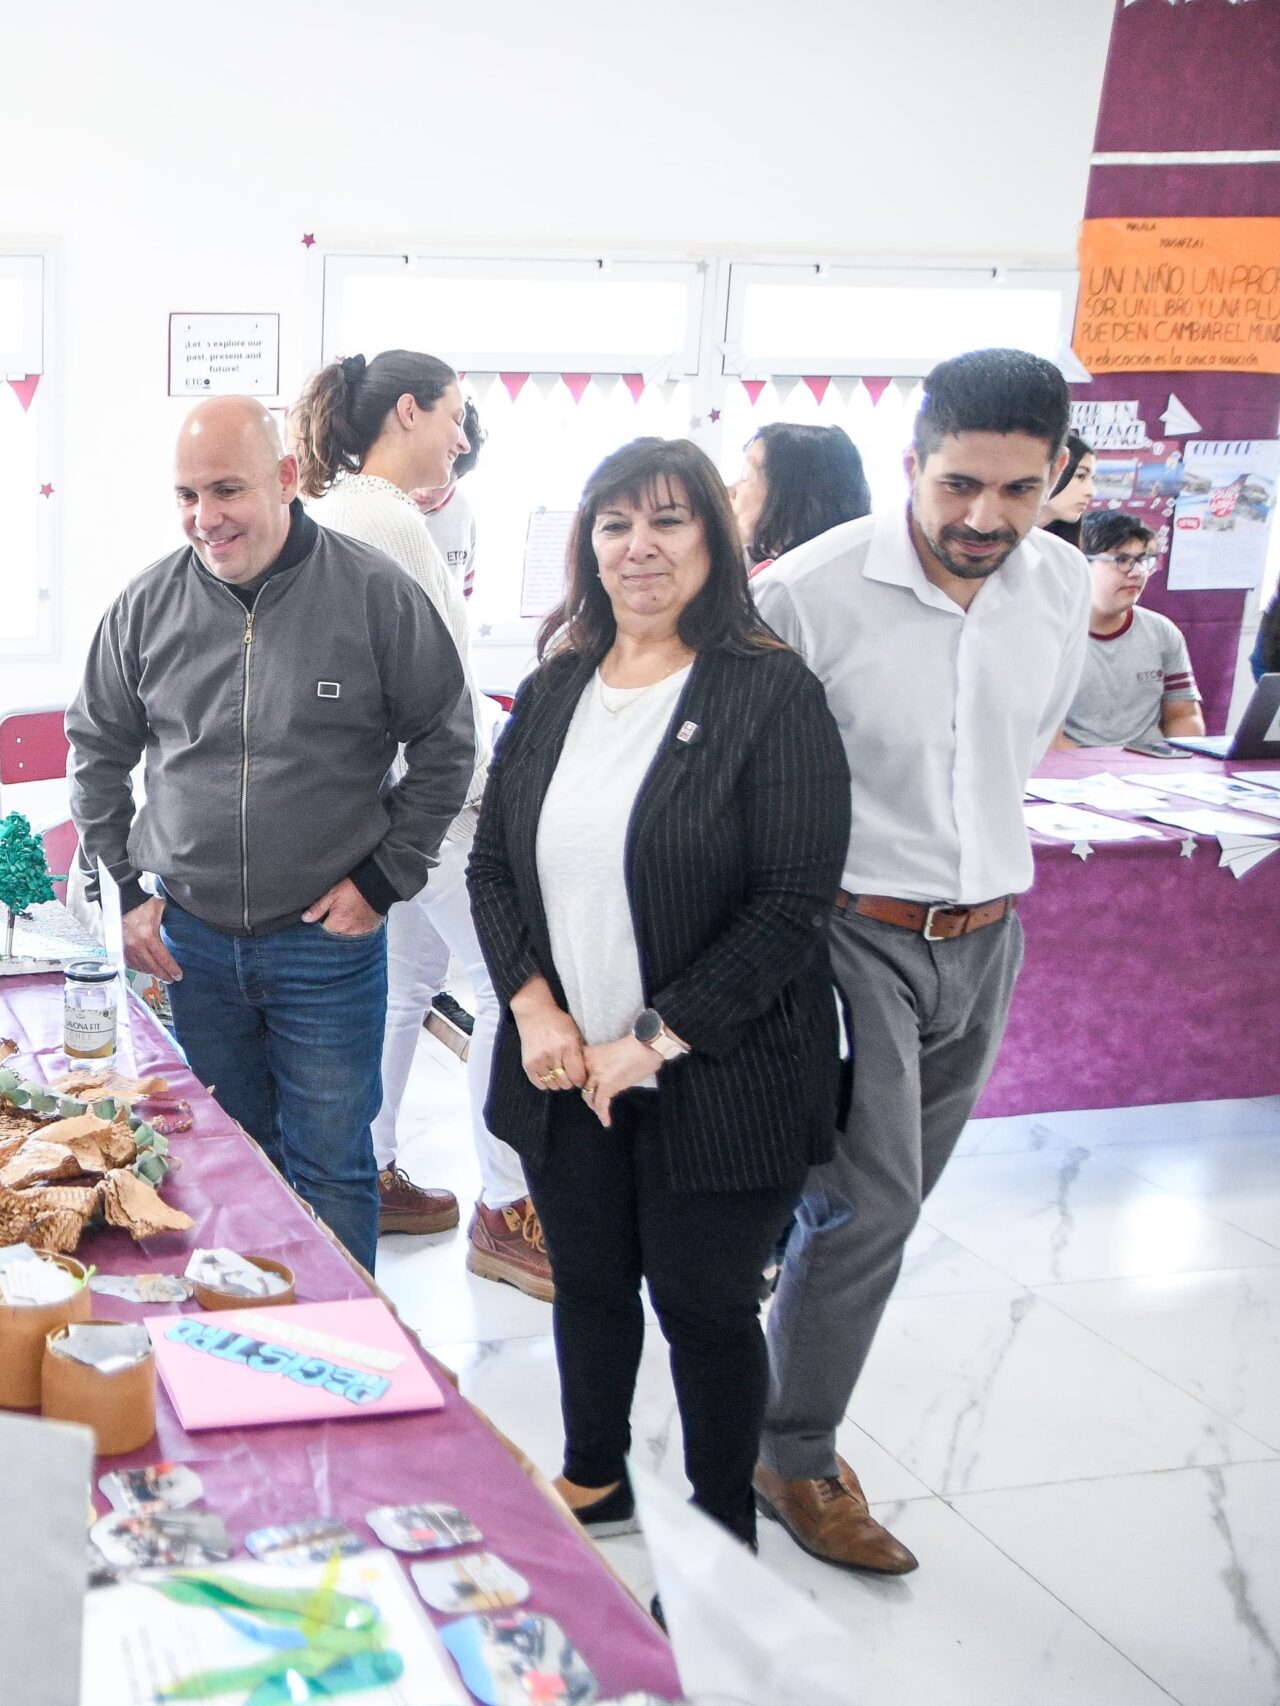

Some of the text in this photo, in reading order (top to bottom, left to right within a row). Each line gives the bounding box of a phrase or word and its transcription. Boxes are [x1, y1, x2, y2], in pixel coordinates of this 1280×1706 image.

[1088, 266, 1125, 296] UN
[1192, 266, 1226, 295] UN
[1081, 321, 1149, 343] PUEDEN
[163, 1317, 393, 1406] REGISTRO
